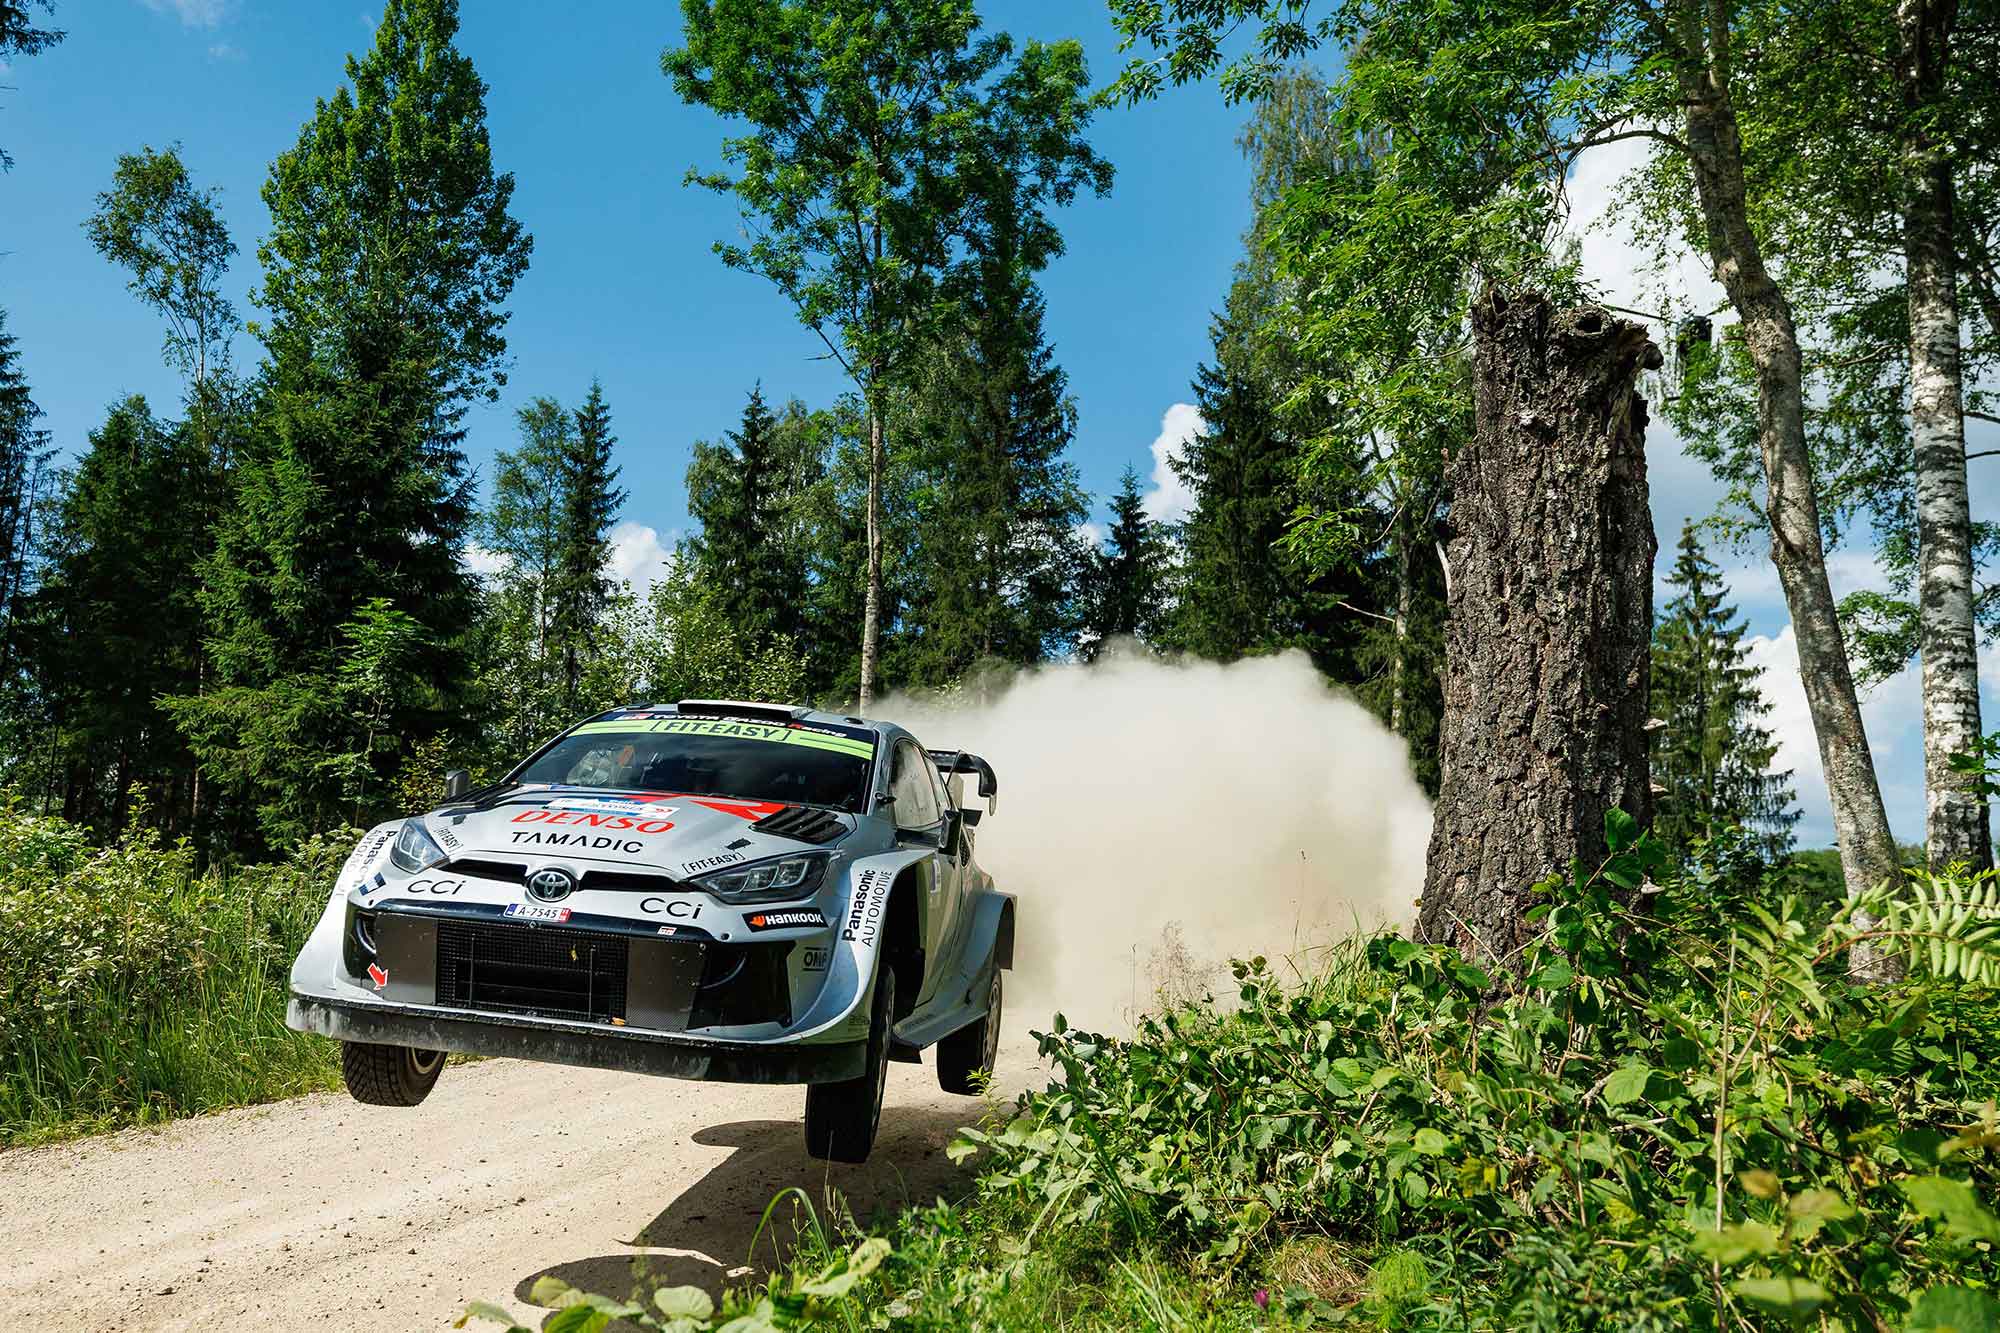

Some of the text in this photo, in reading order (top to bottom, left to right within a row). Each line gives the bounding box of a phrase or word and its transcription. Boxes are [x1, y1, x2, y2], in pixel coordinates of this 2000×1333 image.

[511, 810, 676, 833] DENSO
[511, 831, 644, 853] TAMADIC
[517, 905, 559, 919] A-7545
[841, 869, 876, 942] Panasonic
[861, 871, 893, 948] AUTOMOTIVE
